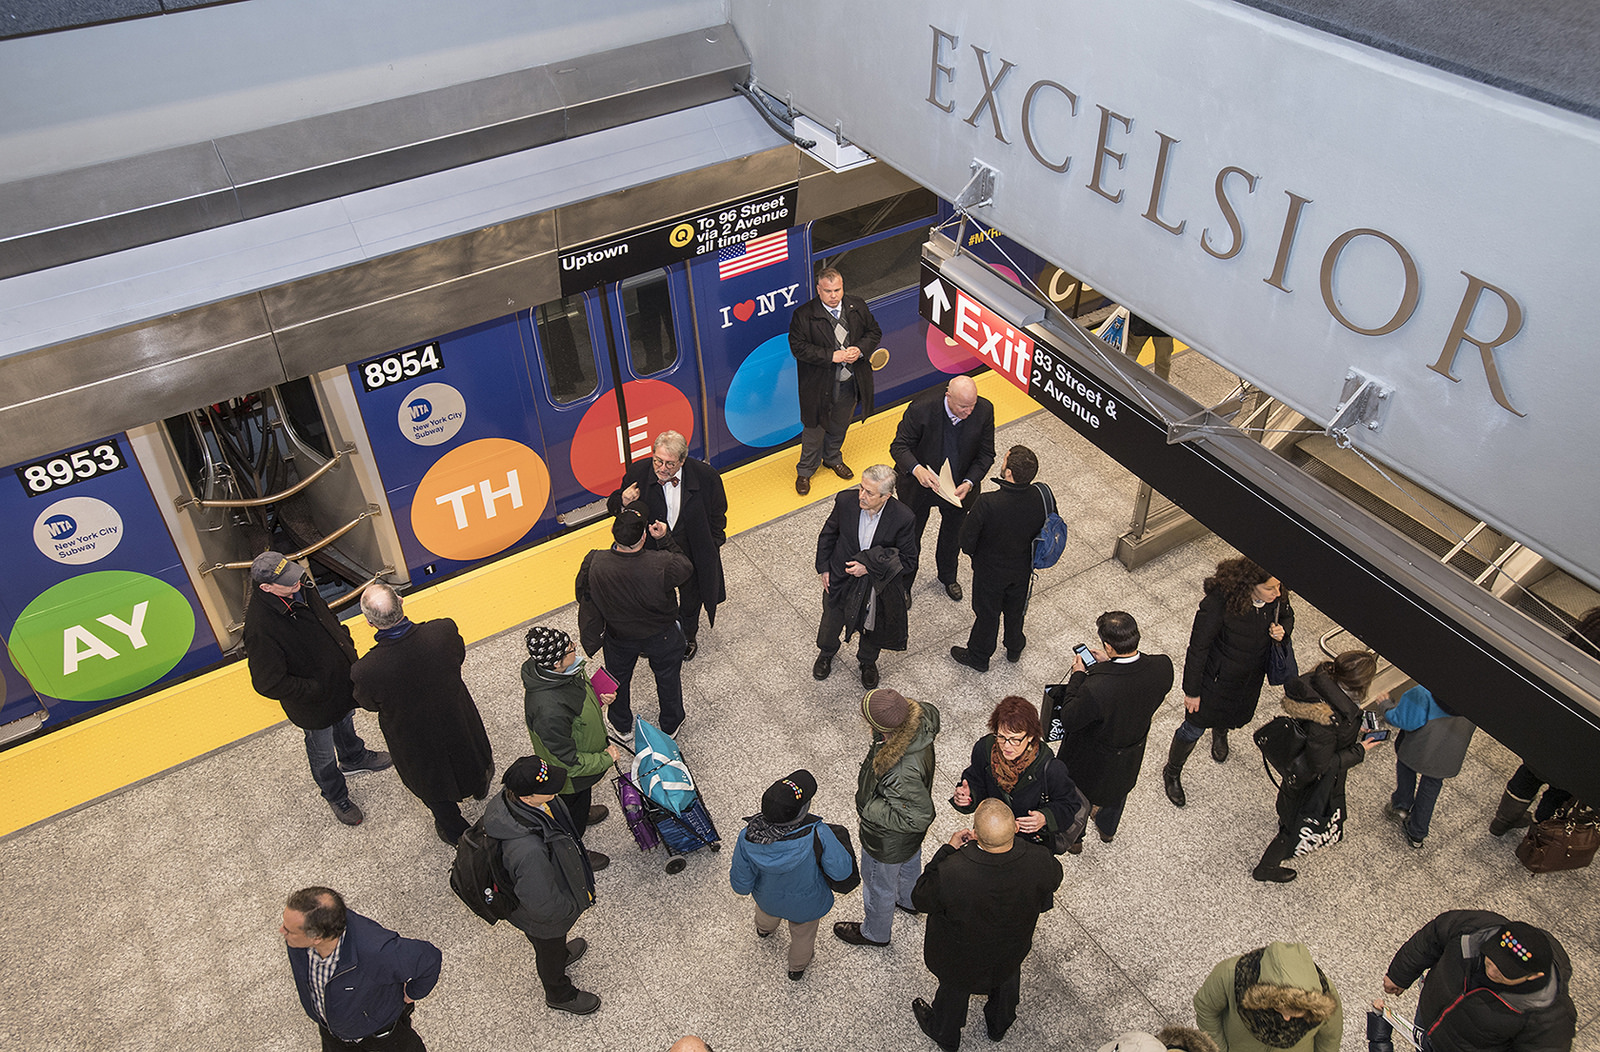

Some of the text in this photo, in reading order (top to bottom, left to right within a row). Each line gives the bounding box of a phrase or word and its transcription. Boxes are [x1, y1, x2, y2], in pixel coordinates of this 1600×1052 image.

[696, 195, 786, 230] To 96 Street
[696, 208, 789, 243] via 2 Avenue
[925, 24, 1527, 418] EXCELSIOR
[676, 229, 688, 242] Q
[696, 228, 758, 255] all times
[562, 243, 629, 271] Uptown
[719, 305, 734, 328] I
[956, 294, 1030, 386] Exit
[364, 345, 440, 388] 8954
[1031, 370, 1100, 429] 2 Avenue
[1034, 349, 1118, 420] 83 Street &
[408, 404, 429, 420] MTA
[412, 412, 462, 432] New York City
[415, 425, 444, 440] Subway
[616, 416, 652, 464] E
[24, 445, 120, 492] 8953
[435, 469, 524, 530] TH
[44, 520, 73, 538] MTA
[54, 526, 118, 551] New York City
[58, 542, 96, 558] Subway
[426, 565, 433, 574] 1
[64, 600, 149, 676] AY
